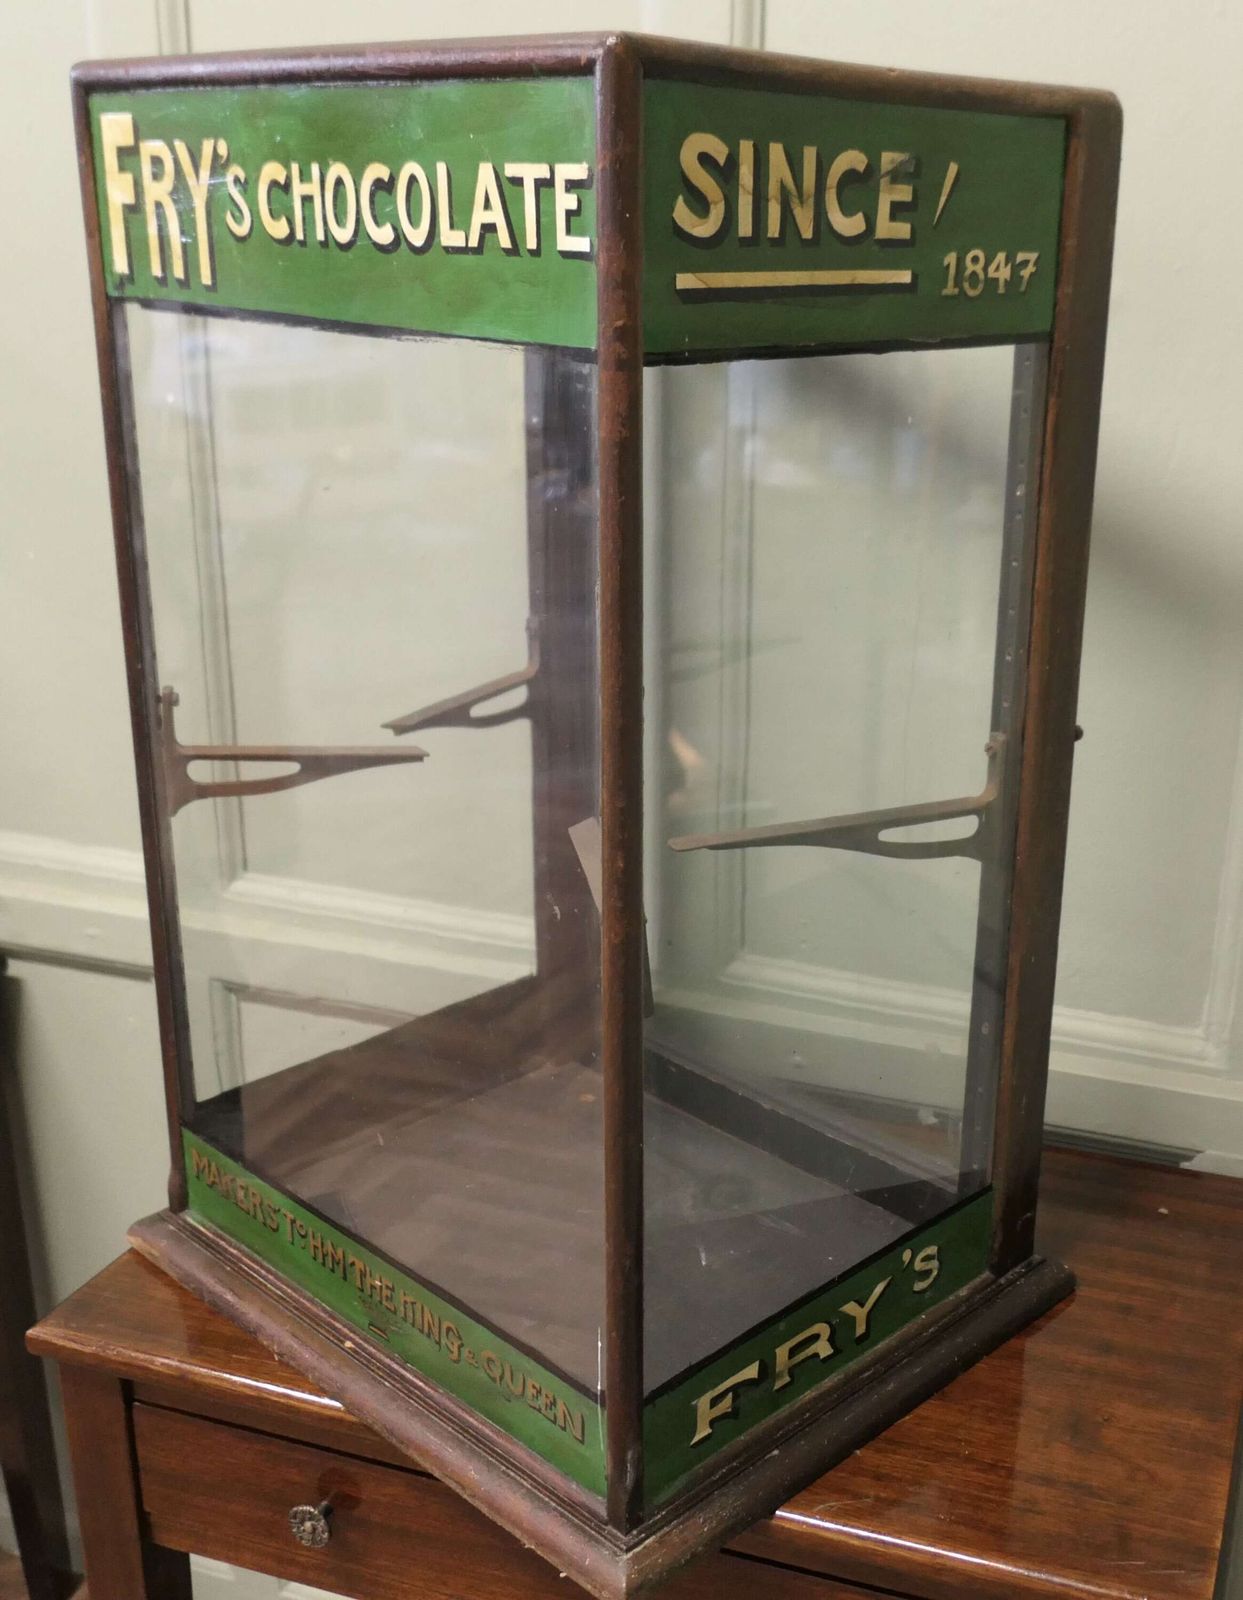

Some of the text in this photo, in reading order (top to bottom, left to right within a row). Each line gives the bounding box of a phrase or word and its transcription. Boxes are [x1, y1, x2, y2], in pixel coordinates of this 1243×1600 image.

[256, 160, 593, 256] CHOCOLATE
[672, 131, 915, 243] SINCE
[941, 248, 1040, 297] 1847
[191, 1148, 280, 1233] MAKERS
[348, 1252, 397, 1315] THE
[400, 1290, 464, 1365] KING
[480, 1348, 586, 1446] QUEEN
[689, 1244, 939, 1448] FRY'S
